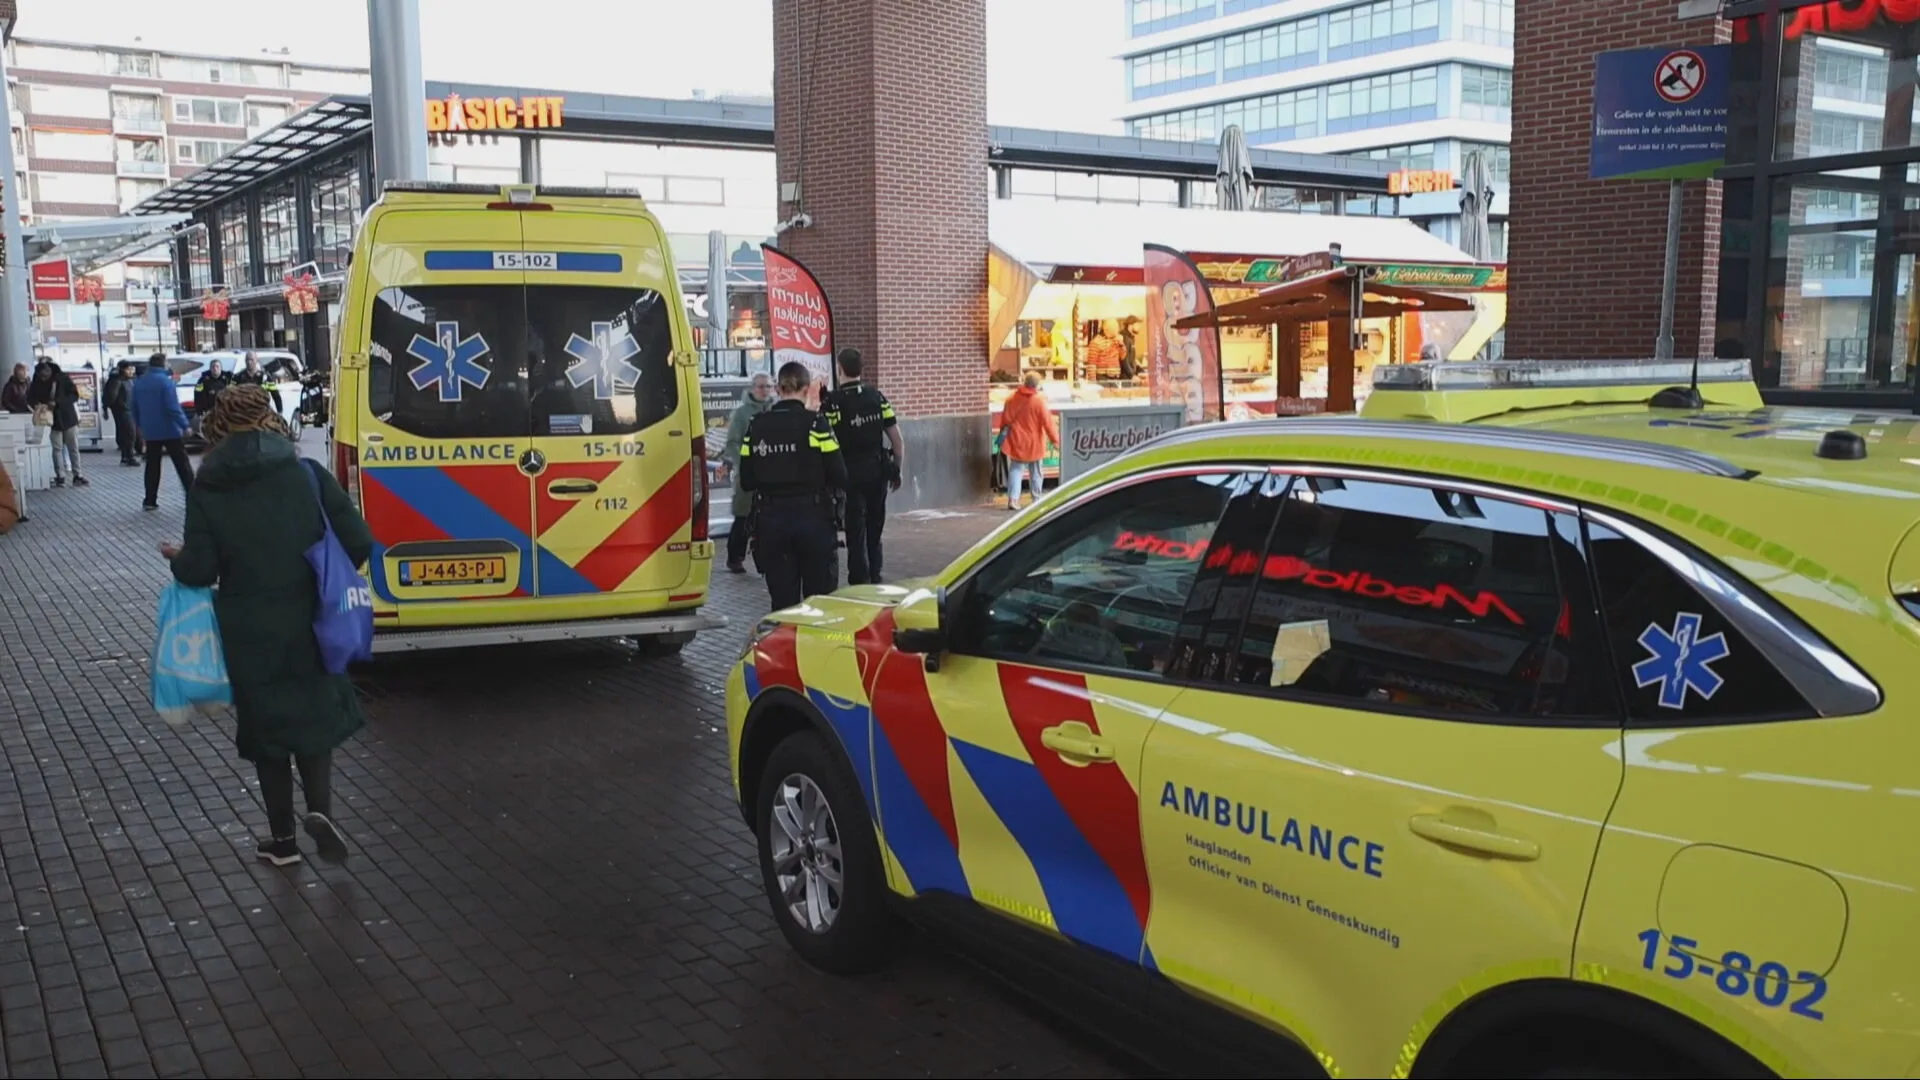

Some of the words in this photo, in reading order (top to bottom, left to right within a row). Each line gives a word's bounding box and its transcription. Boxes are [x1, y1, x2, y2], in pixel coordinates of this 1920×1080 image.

[1614, 110, 1642, 119] Gelieve
[1645, 109, 1656, 118] de
[1658, 108, 1682, 119] vogels
[1685, 108, 1701, 117] niet
[1703, 107, 1712, 116] te
[1642, 125, 1649, 135] in
[1652, 125, 1661, 134] de
[498, 254, 552, 267] 15-102
[683, 293, 709, 318] FC
[583, 442, 645, 457] 15-102
[1072, 426, 1166, 455] Lekkerbek
[363, 443, 516, 461] AMBULANCE
[603, 498, 628, 511] 112
[418, 561, 495, 580] J-443-PJ
[1160, 781, 1384, 878] AMBULANCE
[1185, 833, 1251, 865] Haaglanden
[1188, 855, 1231, 879] Officier
[1236, 874, 1257, 889] van
[1262, 882, 1301, 906] Dienst
[1306, 900, 1400, 948] Geneeskundig
[1637, 928, 1827, 1022] 15-802
